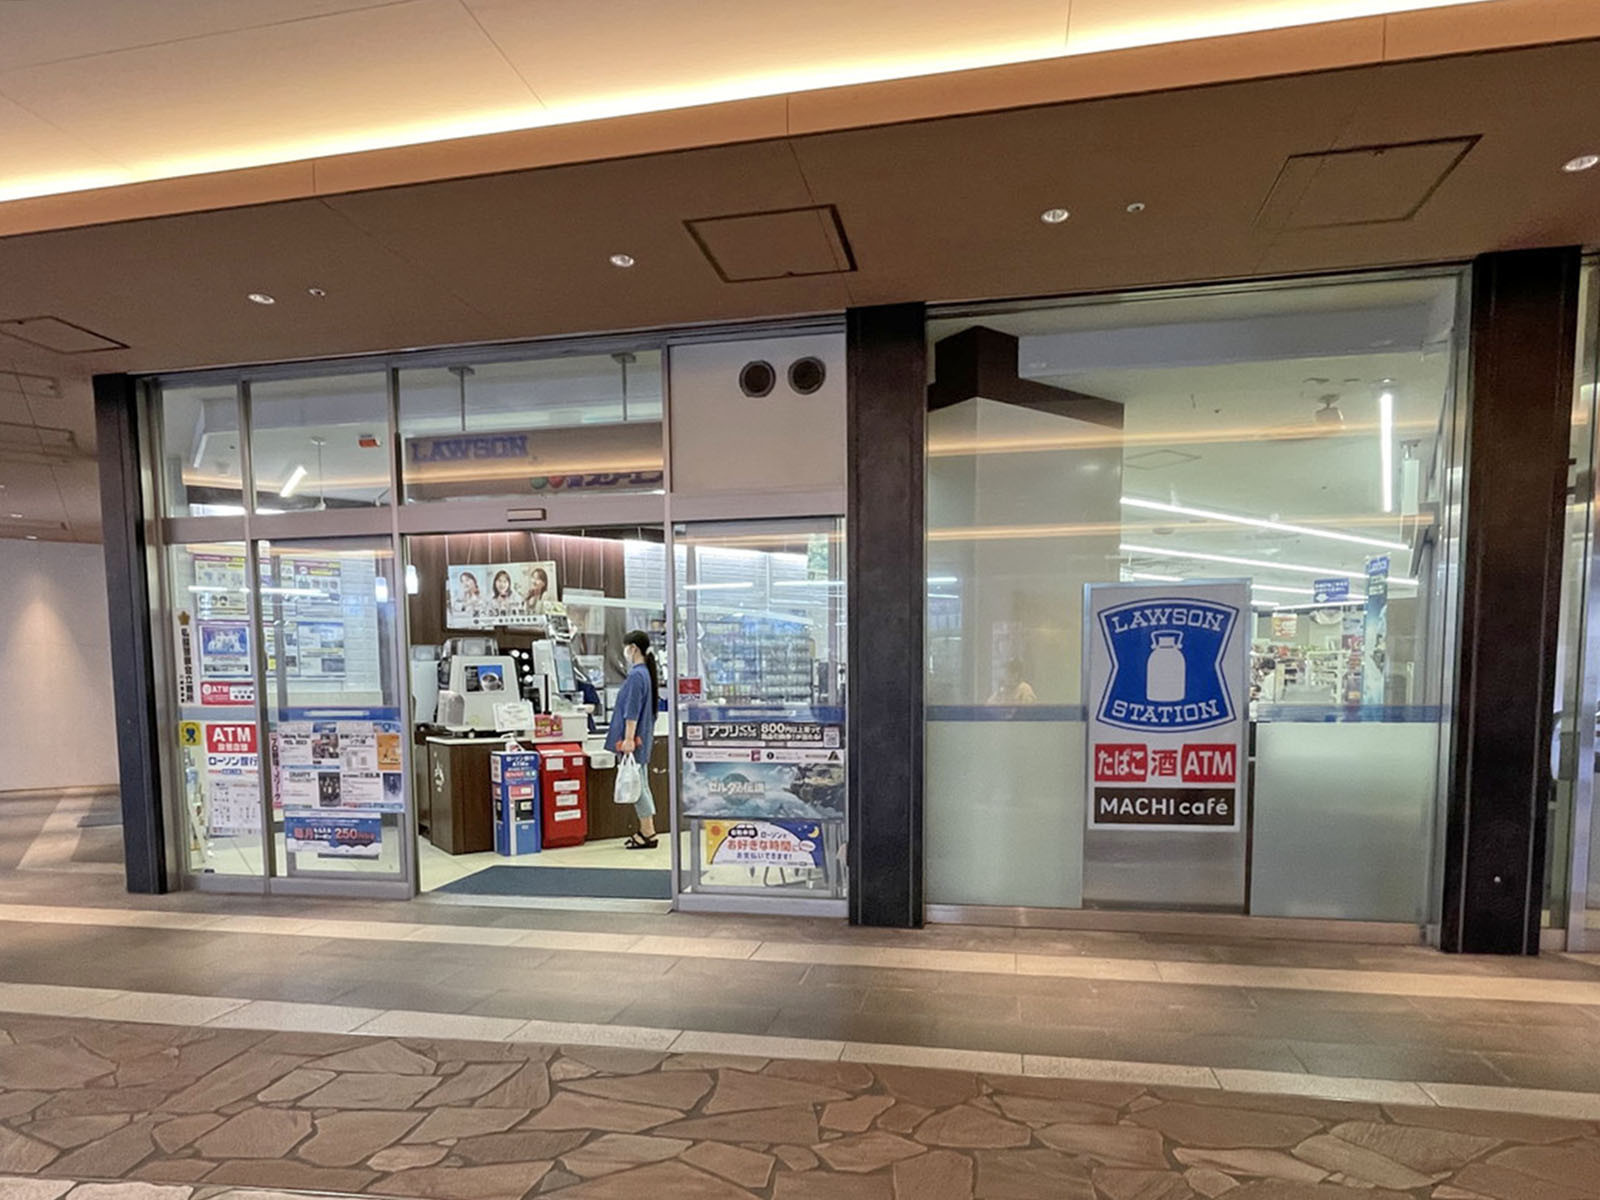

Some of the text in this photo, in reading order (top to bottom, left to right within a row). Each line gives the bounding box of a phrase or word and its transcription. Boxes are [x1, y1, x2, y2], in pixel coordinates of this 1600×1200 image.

[412, 435, 528, 463] LAWSON
[1112, 608, 1224, 633] LAWSON
[212, 685, 229, 693] ATM
[1111, 699, 1220, 723] STATION
[213, 727, 250, 743] ATM
[208, 756, 258, 767] ローソン銀行
[1098, 749, 1145, 776] たばこ
[1151, 749, 1178, 777] 酒
[1184, 751, 1233, 776] ATM
[1100, 797, 1228, 815] MACHI café
[334, 829, 358, 839] 250
[727, 840, 797, 852] お好きな時間に
